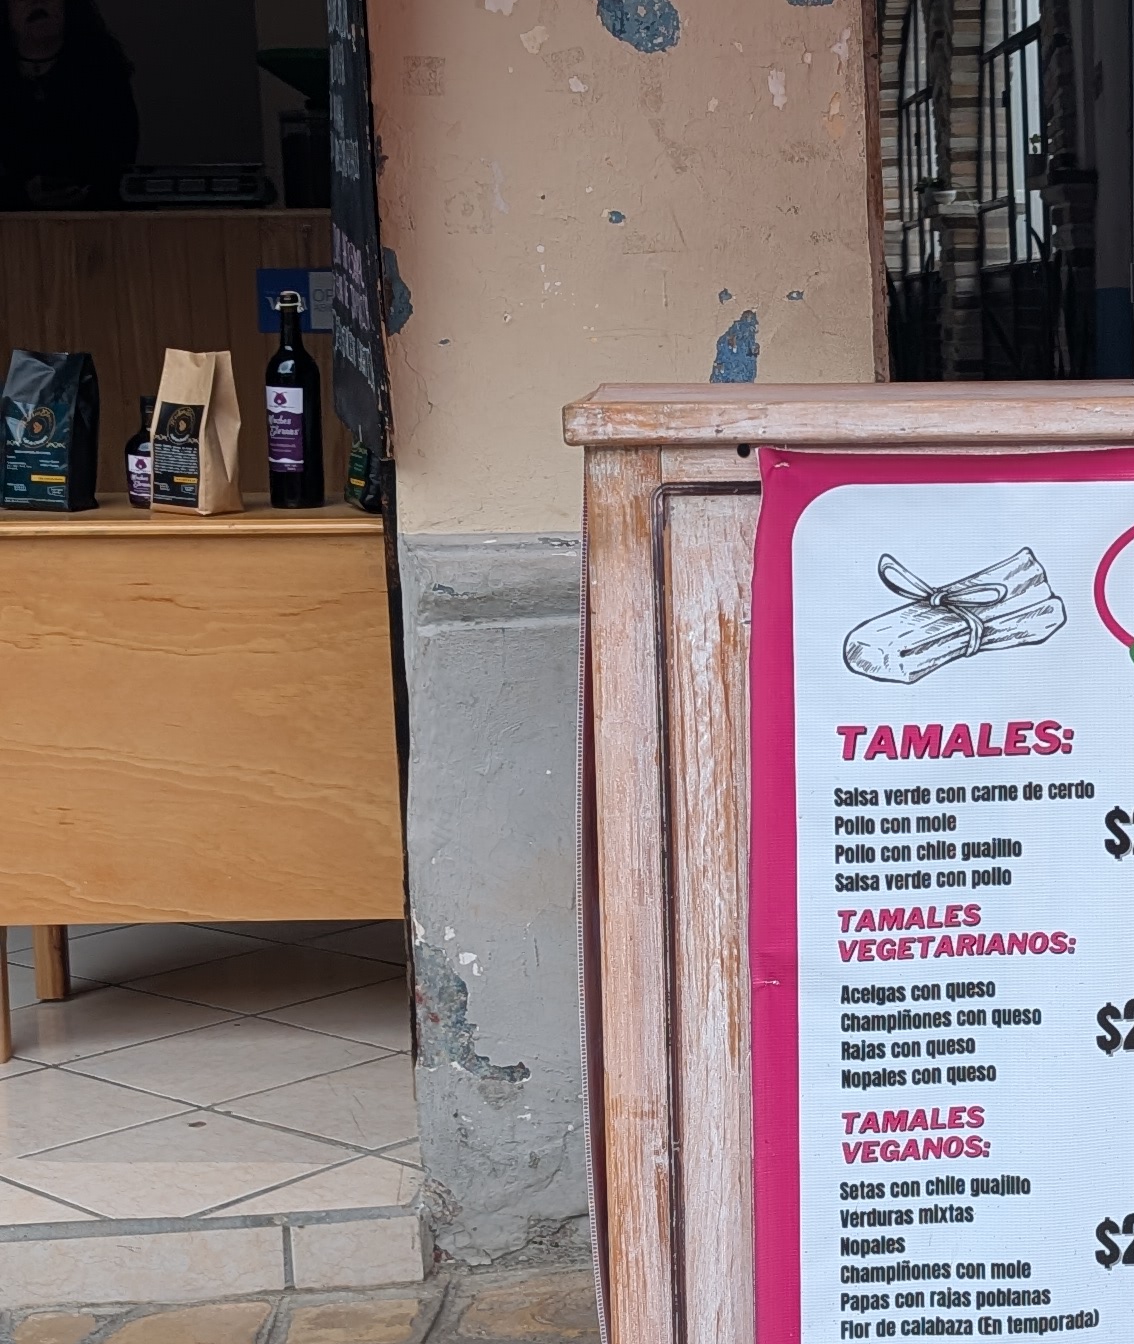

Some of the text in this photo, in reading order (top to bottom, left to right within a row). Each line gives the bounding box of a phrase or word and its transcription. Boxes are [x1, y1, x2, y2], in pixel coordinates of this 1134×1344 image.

[837, 720, 1074, 760] TAMALES:
[834, 780, 1094, 806] Salsa verde con carne de cerdo
[835, 813, 956, 835] Pollo con mole
[836, 838, 1021, 863] Pollo con chile guajillo
[838, 904, 981, 933] TAMALES
[838, 932, 1076, 962] VEGETARIANOS:
[841, 981, 995, 1005] Acelgas con queso
[841, 1009, 1041, 1033] Champiñones con queso
[842, 1106, 985, 1134] TAMALES
[842, 1135, 990, 1164] VEGANOS:
[840, 1204, 973, 1228] Verduras mixtas
[841, 1287, 1050, 1313] Papas con rajas poblanas
[841, 1309, 1099, 1339] Flor de calabaza (En temporada)
